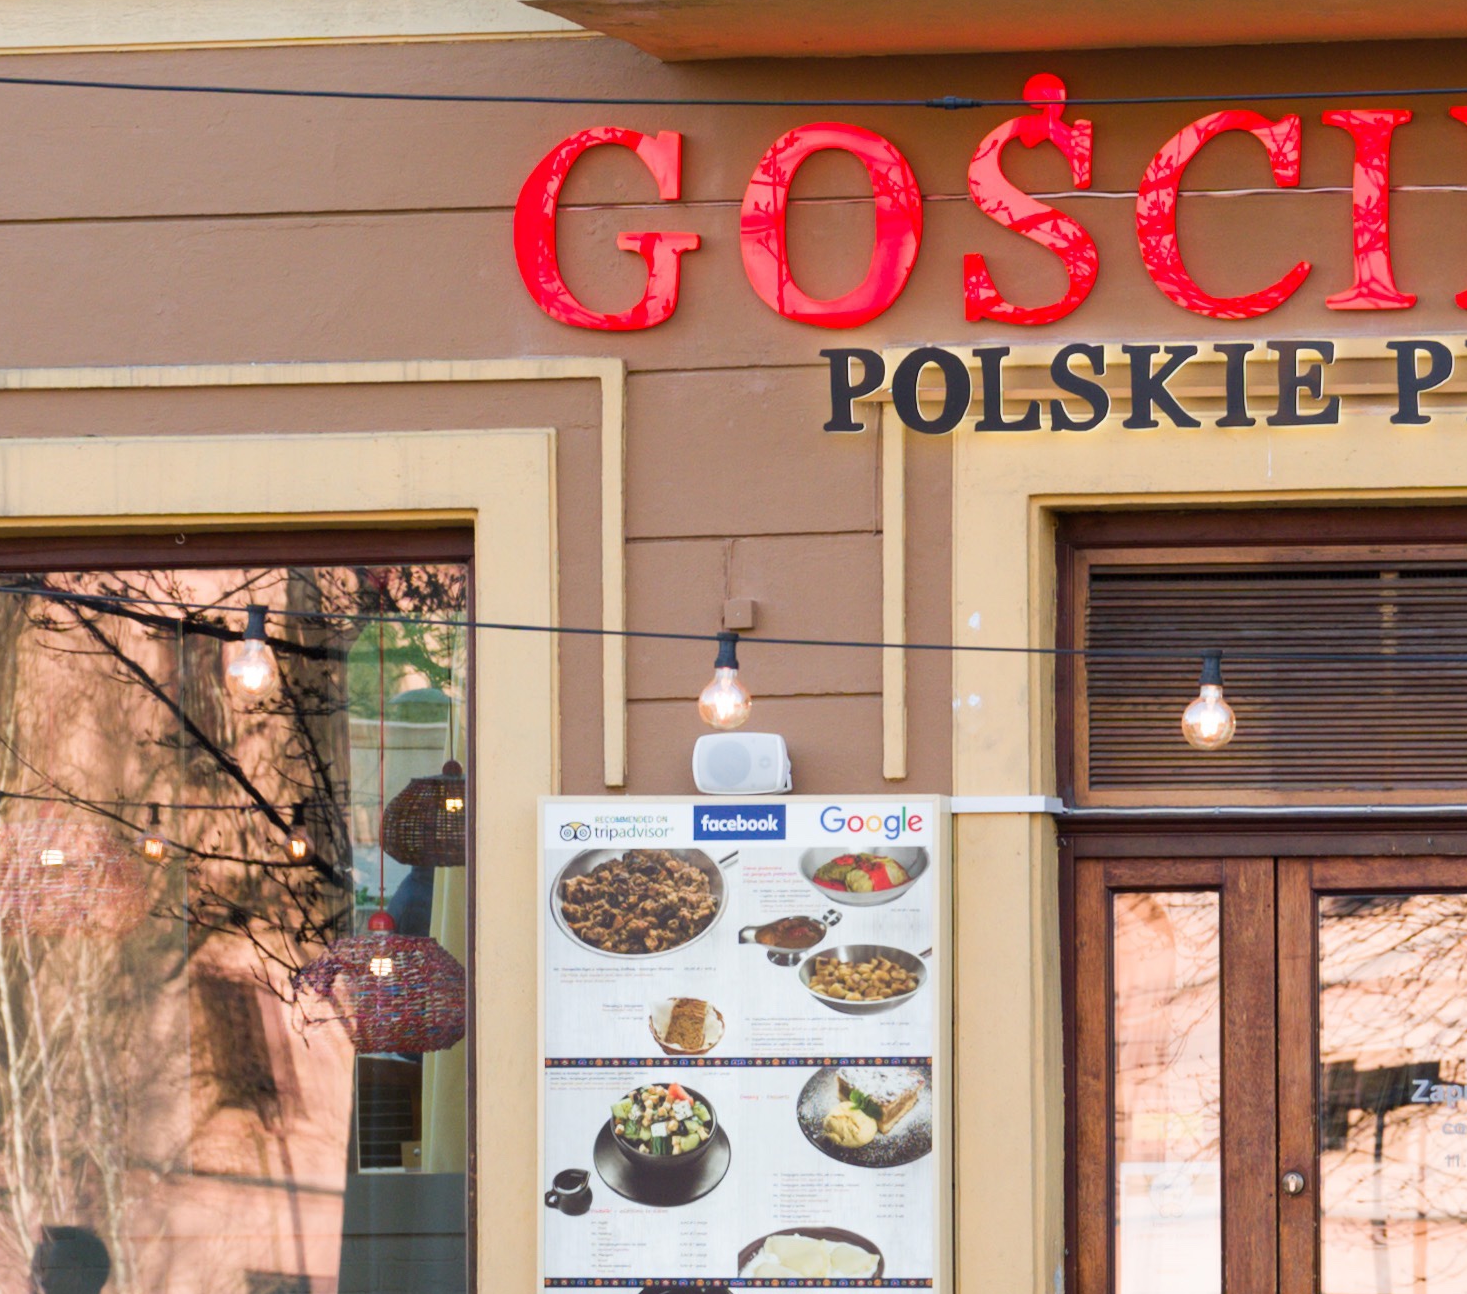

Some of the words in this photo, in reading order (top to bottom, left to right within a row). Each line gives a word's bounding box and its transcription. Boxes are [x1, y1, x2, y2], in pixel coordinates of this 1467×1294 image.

[820, 340, 1341, 437] POLSKIE
[595, 824, 671, 841] tripadvisor
[701, 815, 779, 832] facebook
[820, 806, 923, 840] Google
